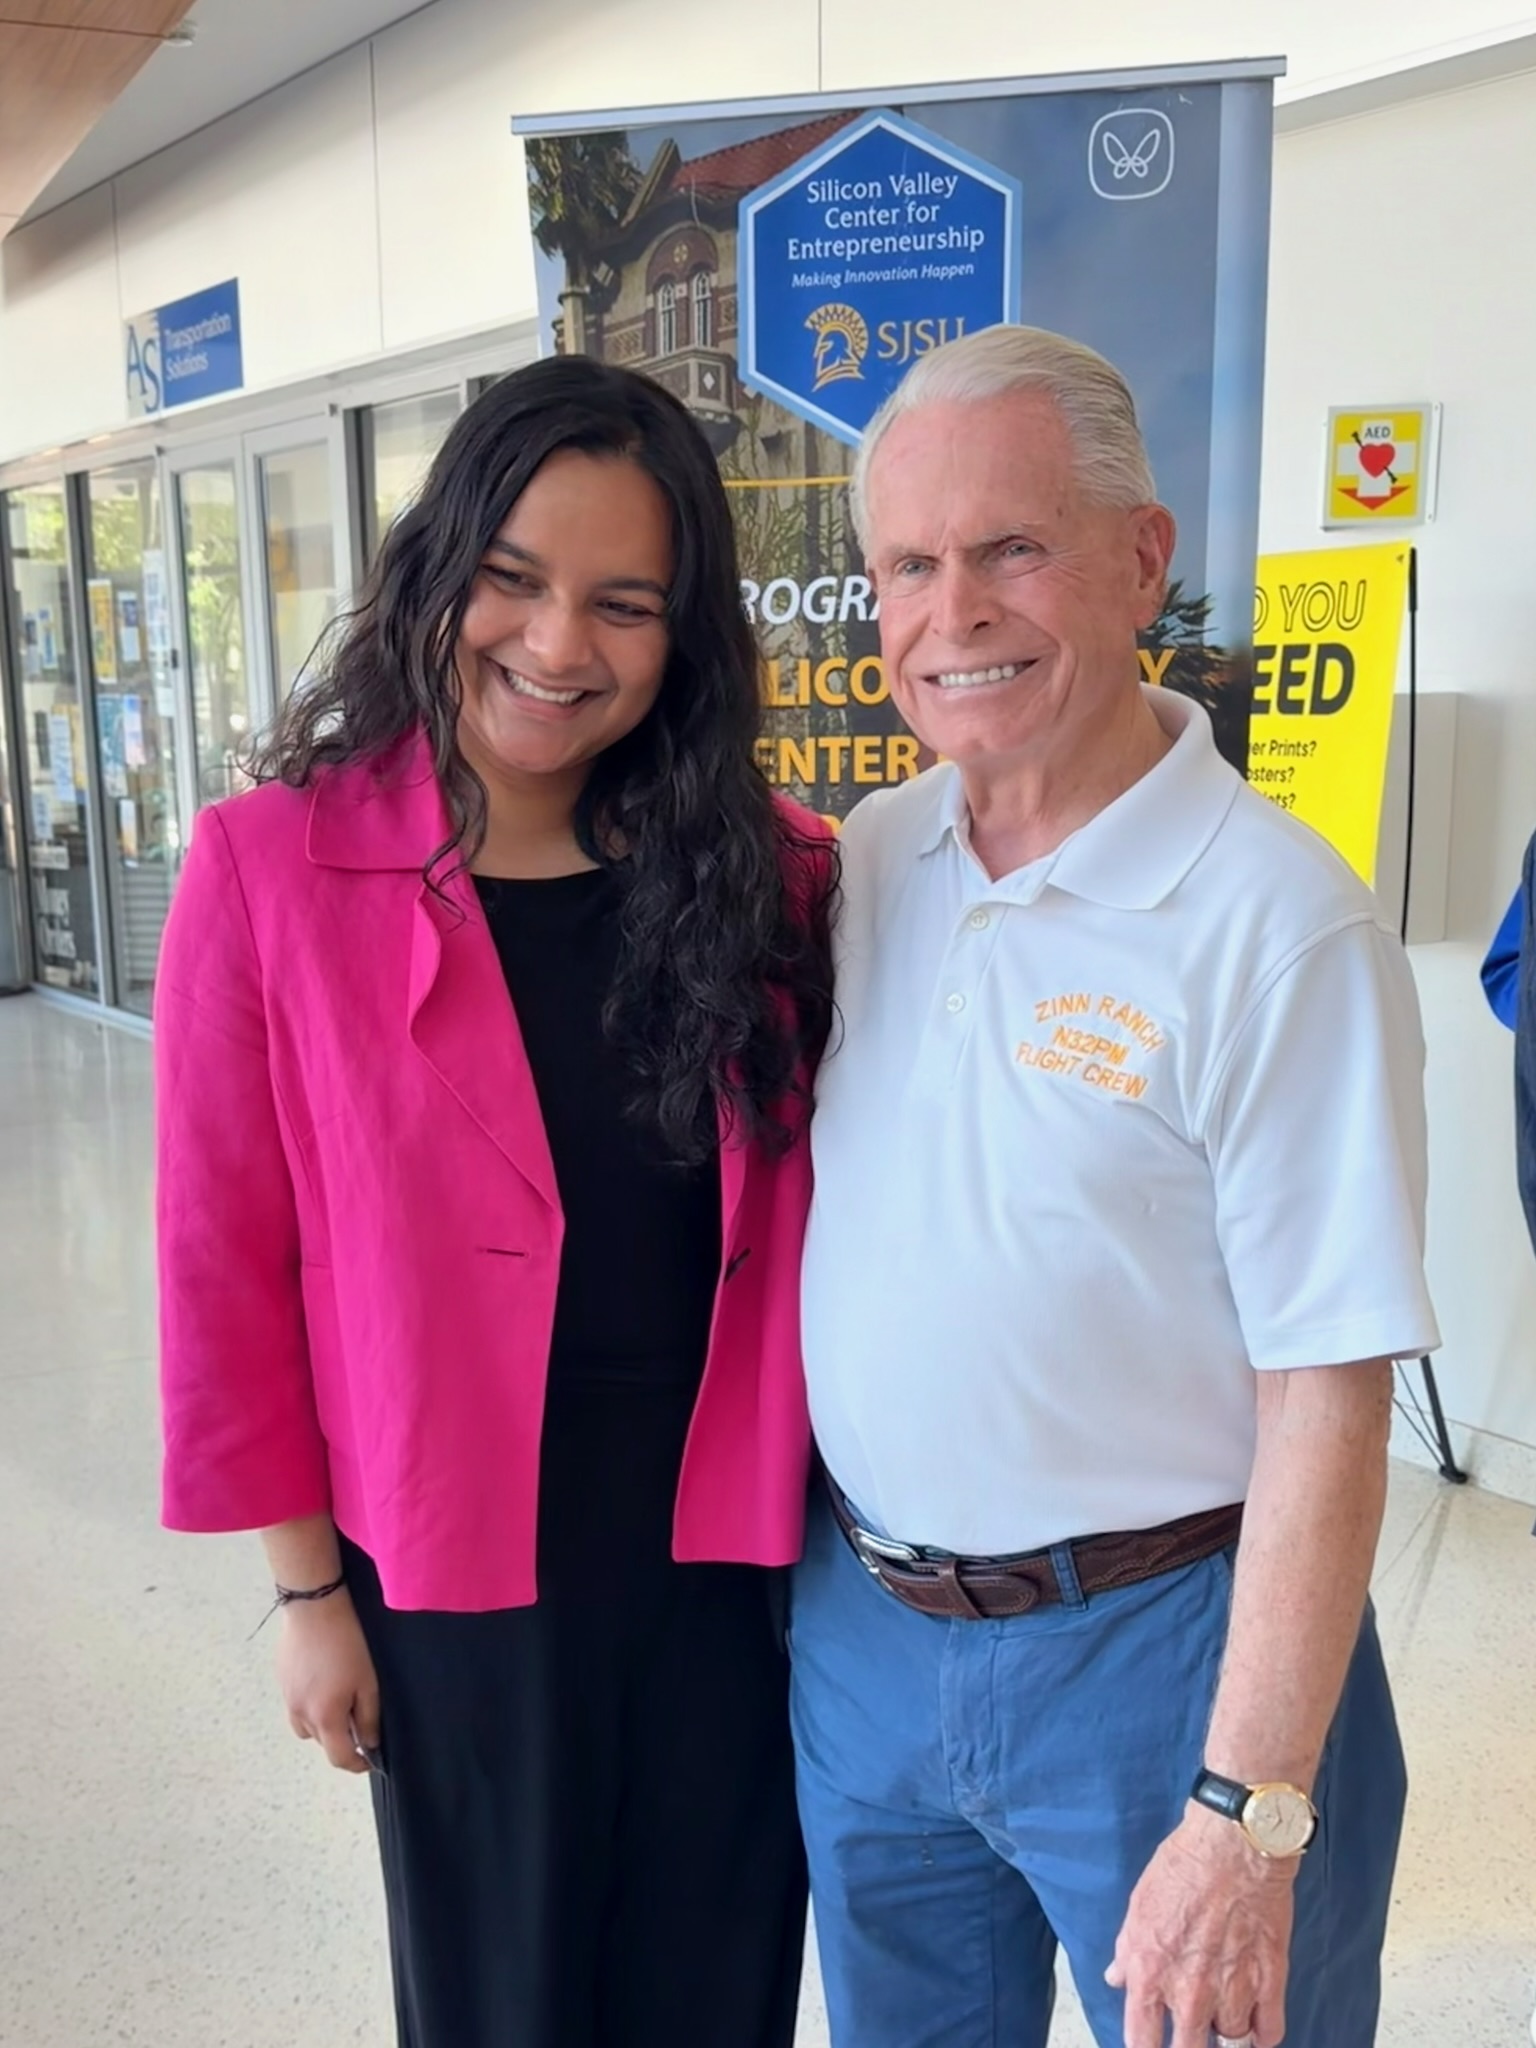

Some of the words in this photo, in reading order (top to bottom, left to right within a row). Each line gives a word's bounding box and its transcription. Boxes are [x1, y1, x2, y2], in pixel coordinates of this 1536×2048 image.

[806, 177, 883, 203] Silicon
[889, 172, 959, 199] Valley
[824, 203, 900, 229] Center
[906, 201, 940, 225] for
[787, 225, 986, 261] Entrepreneurship
[791, 270, 842, 289] Making
[844, 265, 918, 284] Innovation
[921, 262, 975, 282] Happen
[164, 311, 232, 352] Transportation
[877, 316, 965, 365] SJSU
[126, 323, 160, 414] AS
[165, 352, 209, 382] Solutions
[1363, 425, 1392, 440] AED
[1279, 579, 1367, 633] YOU
[1268, 739, 1318, 758] Prints?
[1034, 992, 1092, 1024] ZINN
[1097, 994, 1166, 1054] RANCH
[1014, 1041, 1084, 1076] FLIGHT
[1081, 1062, 1149, 1100] CREW
